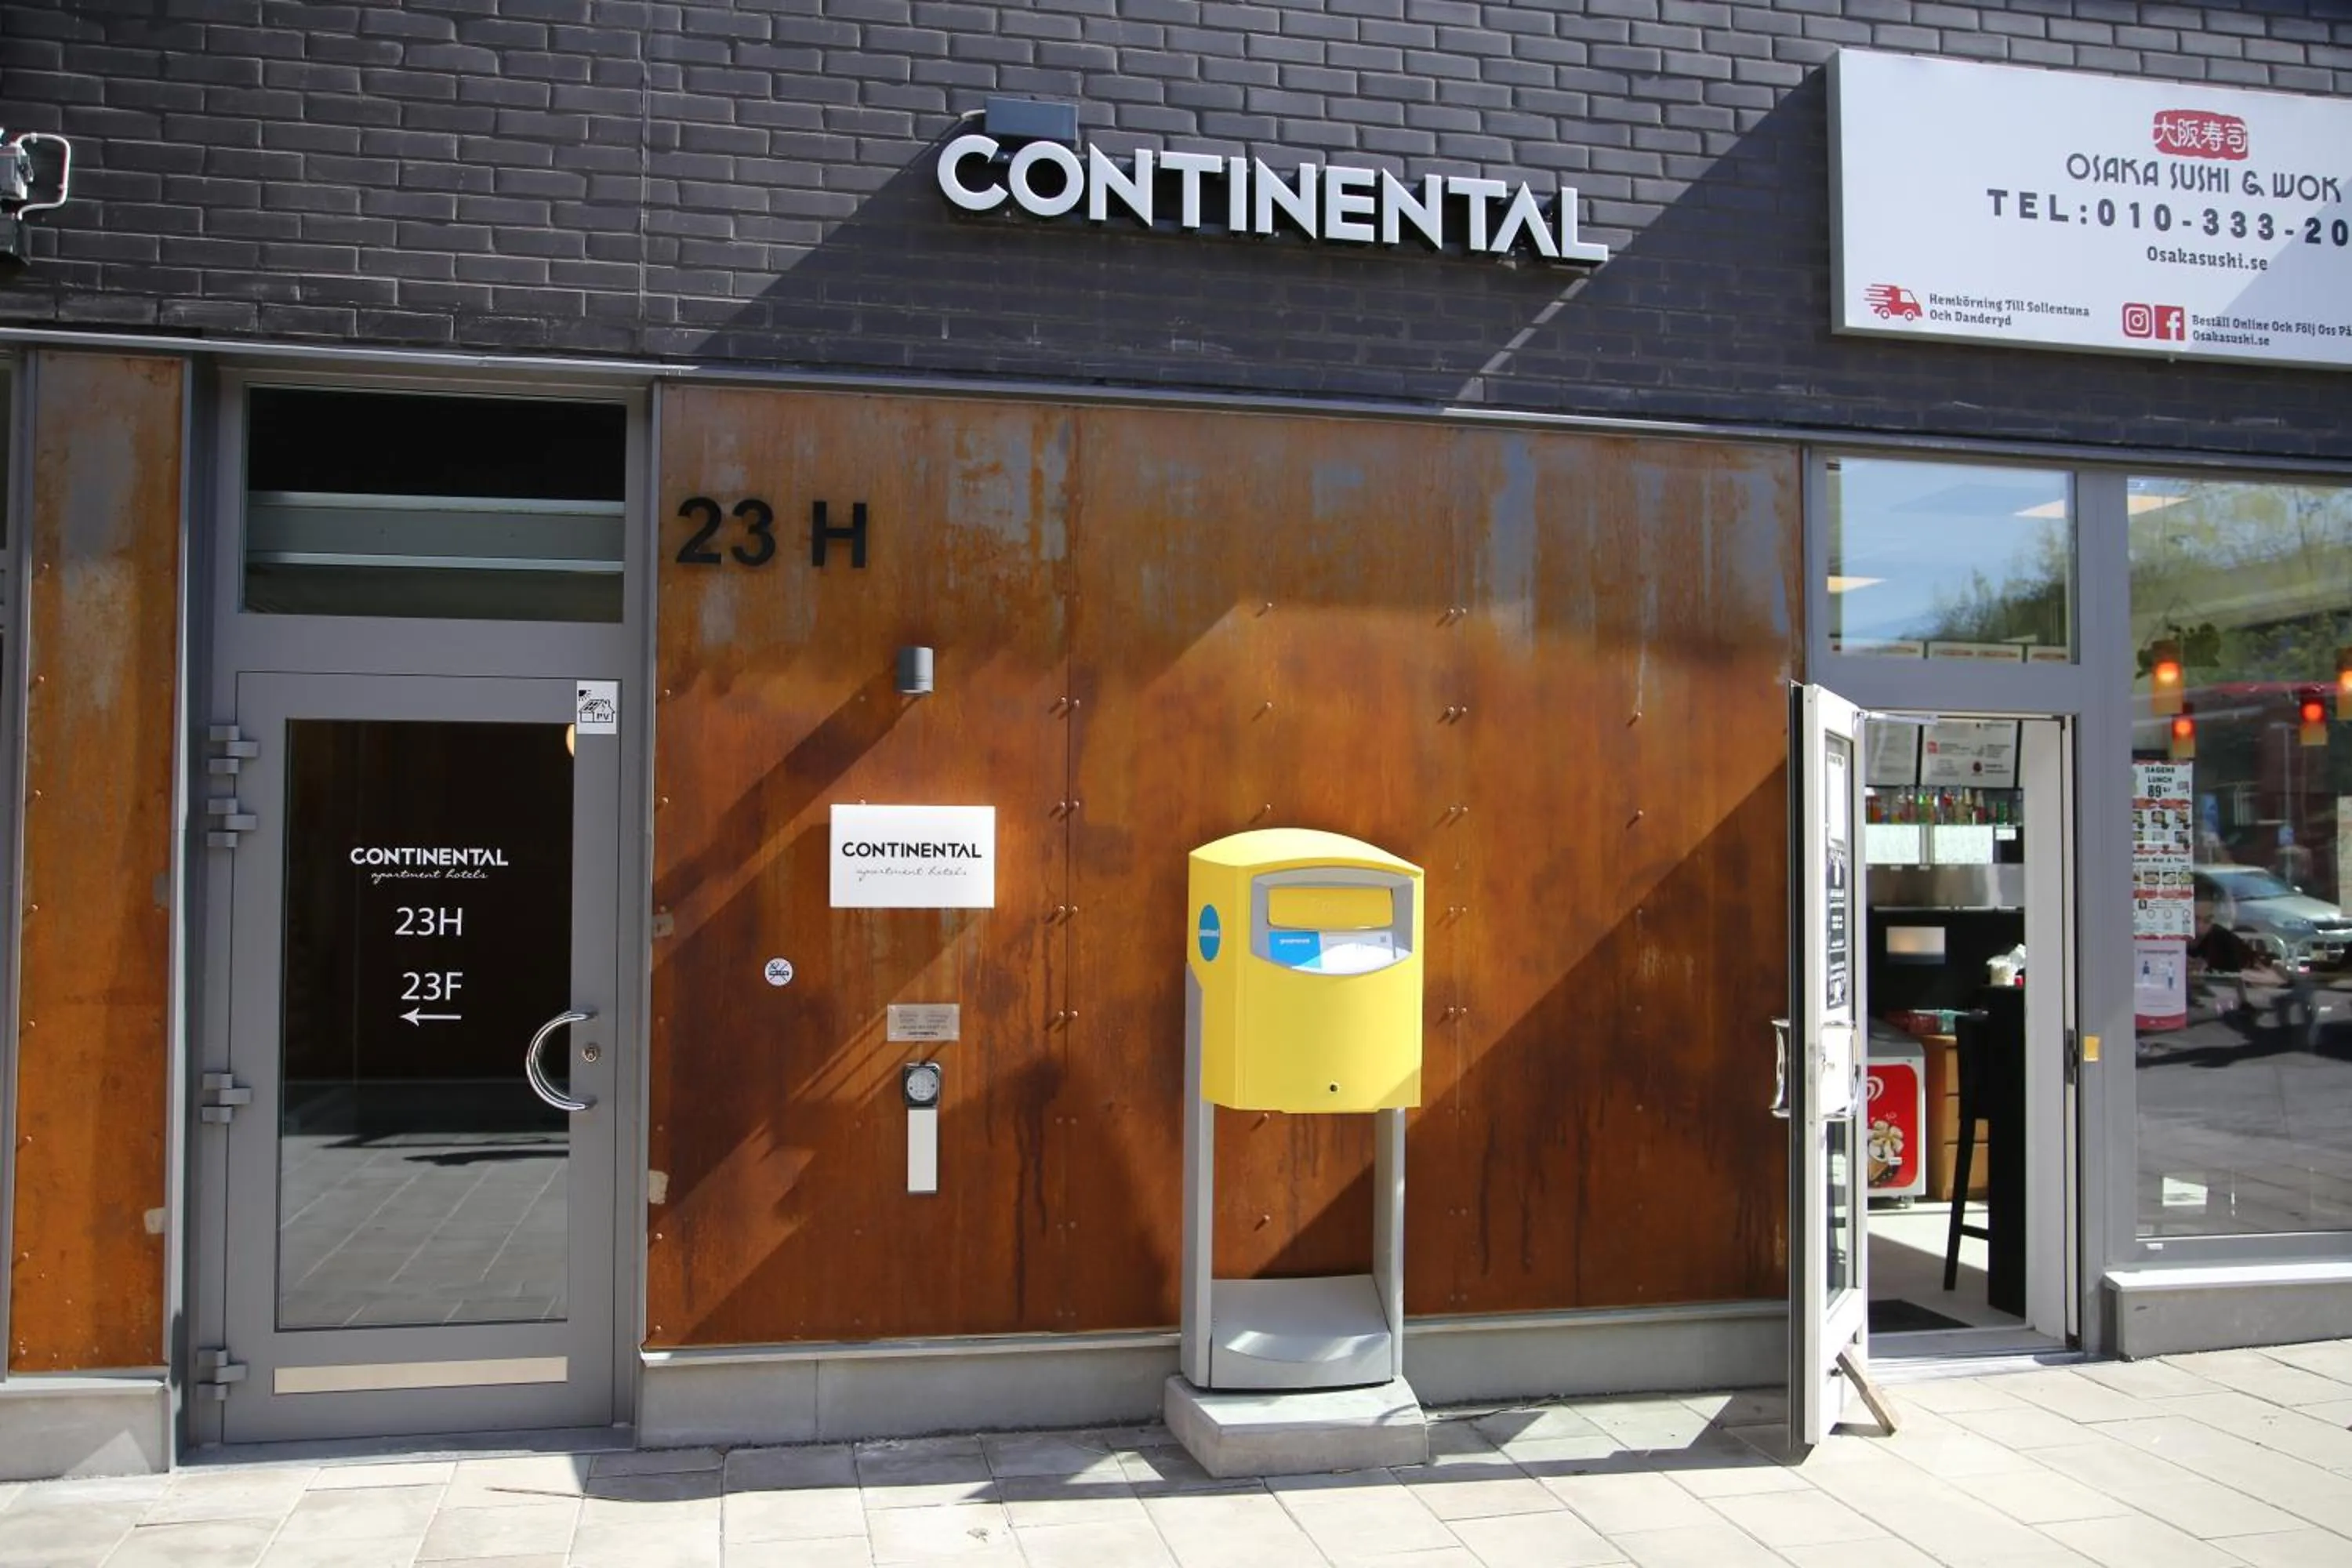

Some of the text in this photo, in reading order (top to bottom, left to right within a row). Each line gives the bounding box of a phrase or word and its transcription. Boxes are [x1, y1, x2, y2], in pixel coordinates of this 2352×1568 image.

[2152, 114, 2248, 154] 大阪寿司
[2066, 153, 2342, 203] OSAKA SUSHI & WOK
[938, 134, 1609, 262] CONTINENTAL
[2147, 245, 2268, 271] Osakasushi.se
[1929, 292, 2090, 317] Hemkörning Till Sollentuna
[1929, 309, 2012, 327] Och Danderyd
[2191, 315, 2230, 328] Beställ
[2233, 318, 2269, 331] Online
[2272, 321, 2292, 333] Och
[2295, 322, 2315, 336] Följ
[2318, 325, 2336, 336] Oss
[2193, 330, 2270, 346] Osakasushi.se
[676, 496, 868, 568] 23 H
[350, 848, 510, 866] CONTINENTAL
[841, 841, 982, 858] CONTINENTAL
[370, 868, 488, 885] apartment hotels
[394, 906, 463, 936] 23H
[401, 971, 464, 1000] 23F
